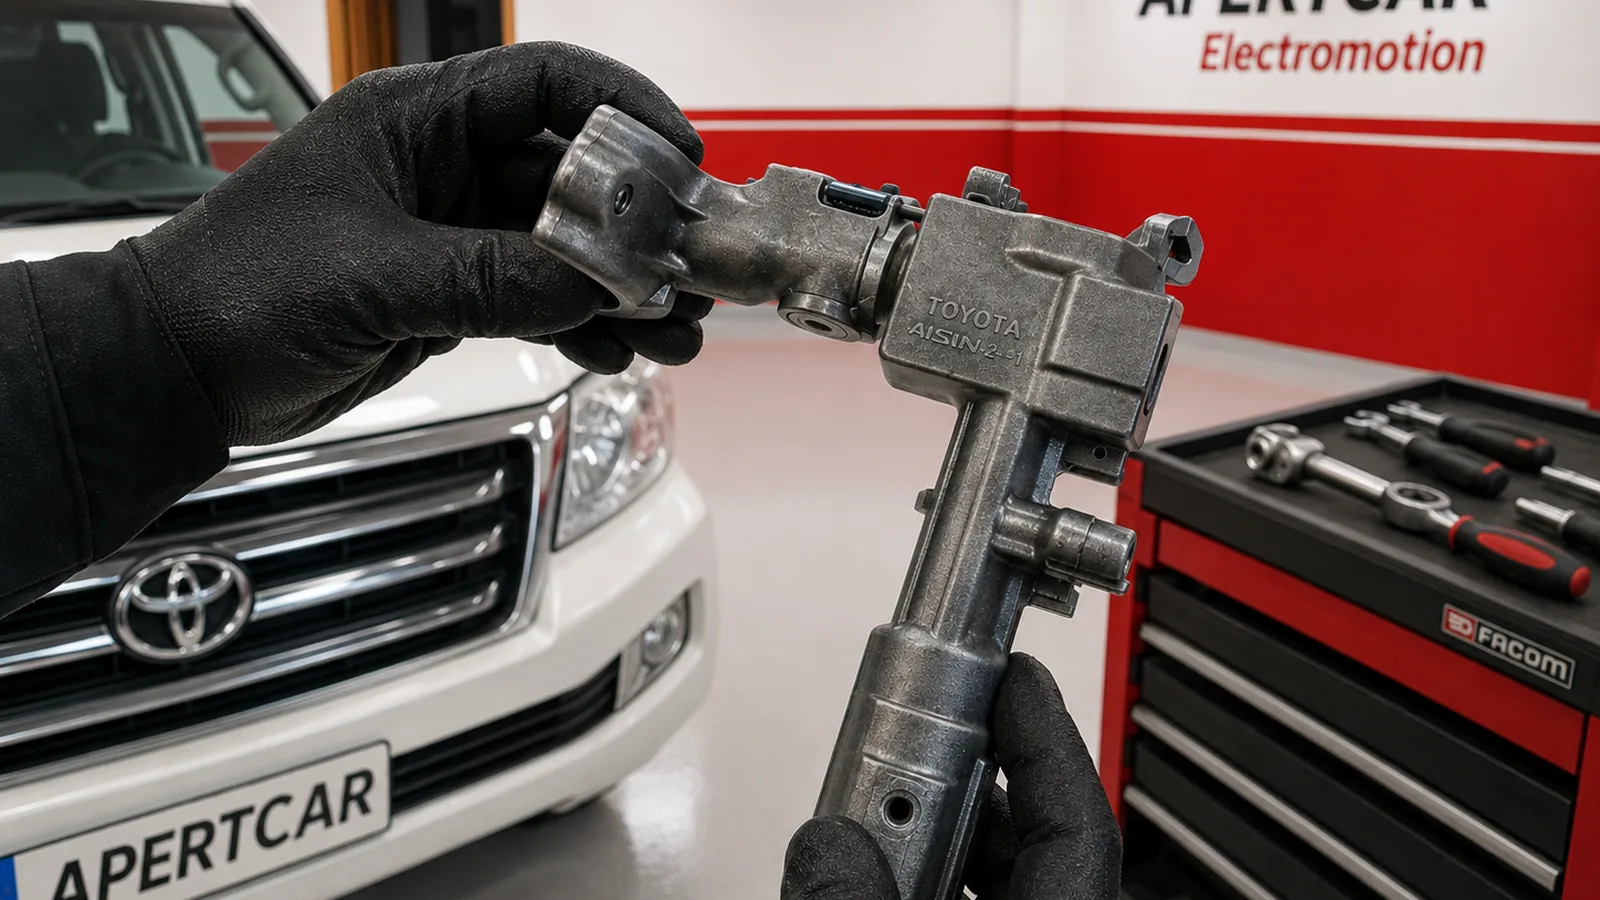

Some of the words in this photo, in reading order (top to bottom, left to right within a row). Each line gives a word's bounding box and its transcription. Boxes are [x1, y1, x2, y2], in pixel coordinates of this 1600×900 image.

[1200, 29, 1485, 73] Electromotion
[928, 296, 1021, 340] TOYOTA
[1477, 626, 1568, 681] FACOM
[52, 769, 374, 900] APERTCAR
